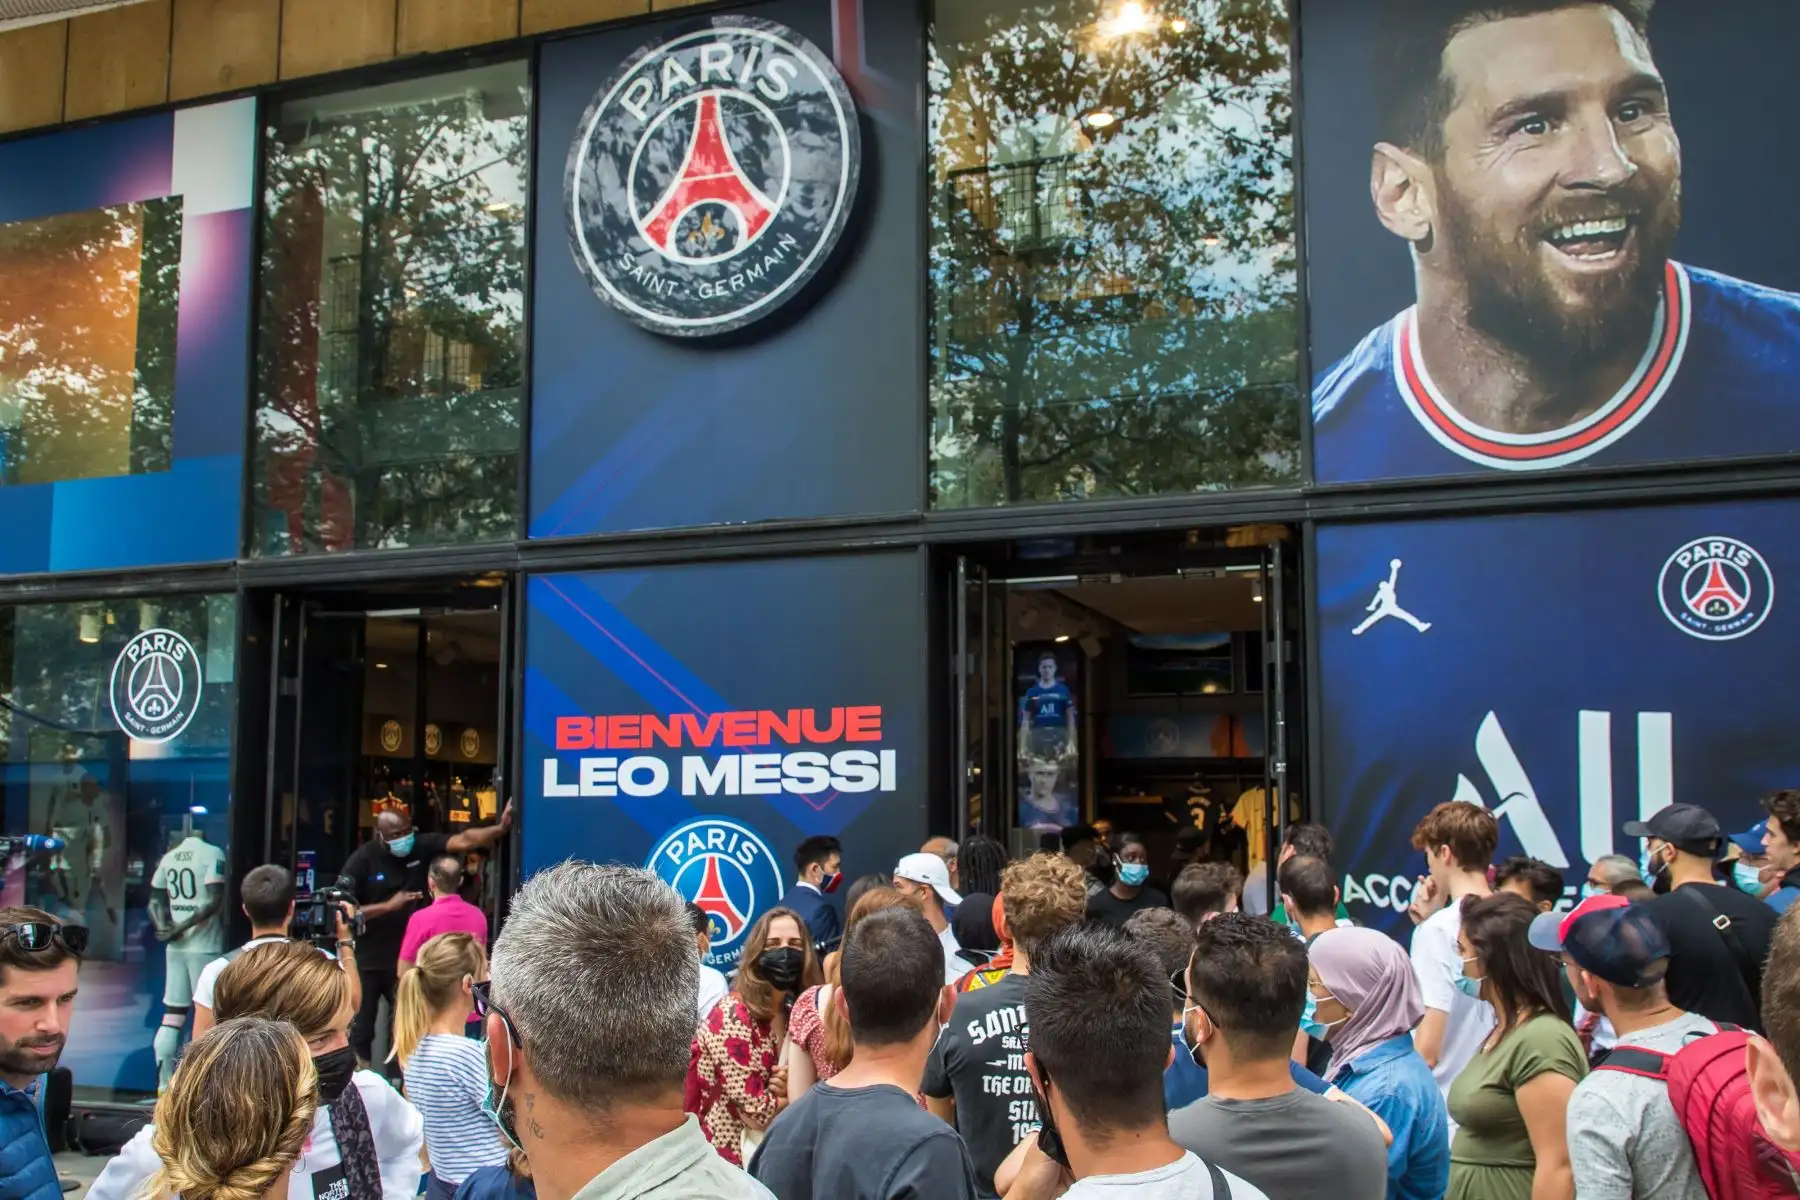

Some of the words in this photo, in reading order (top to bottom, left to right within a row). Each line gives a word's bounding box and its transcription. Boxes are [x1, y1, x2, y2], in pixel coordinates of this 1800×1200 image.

[619, 41, 798, 123] PARIS
[1675, 541, 1753, 569] PARIS
[126, 633, 188, 663] PARIS
[555, 705, 882, 750] BIENVENUE
[543, 756, 670, 797] LEO
[681, 749, 897, 796] MESSI
[665, 828, 759, 866] PARIS
[167, 867, 197, 900] 30
[1343, 873, 1423, 913] ACC
[982, 1075, 1010, 1096] THE
[329, 1179, 344, 1190] THE
